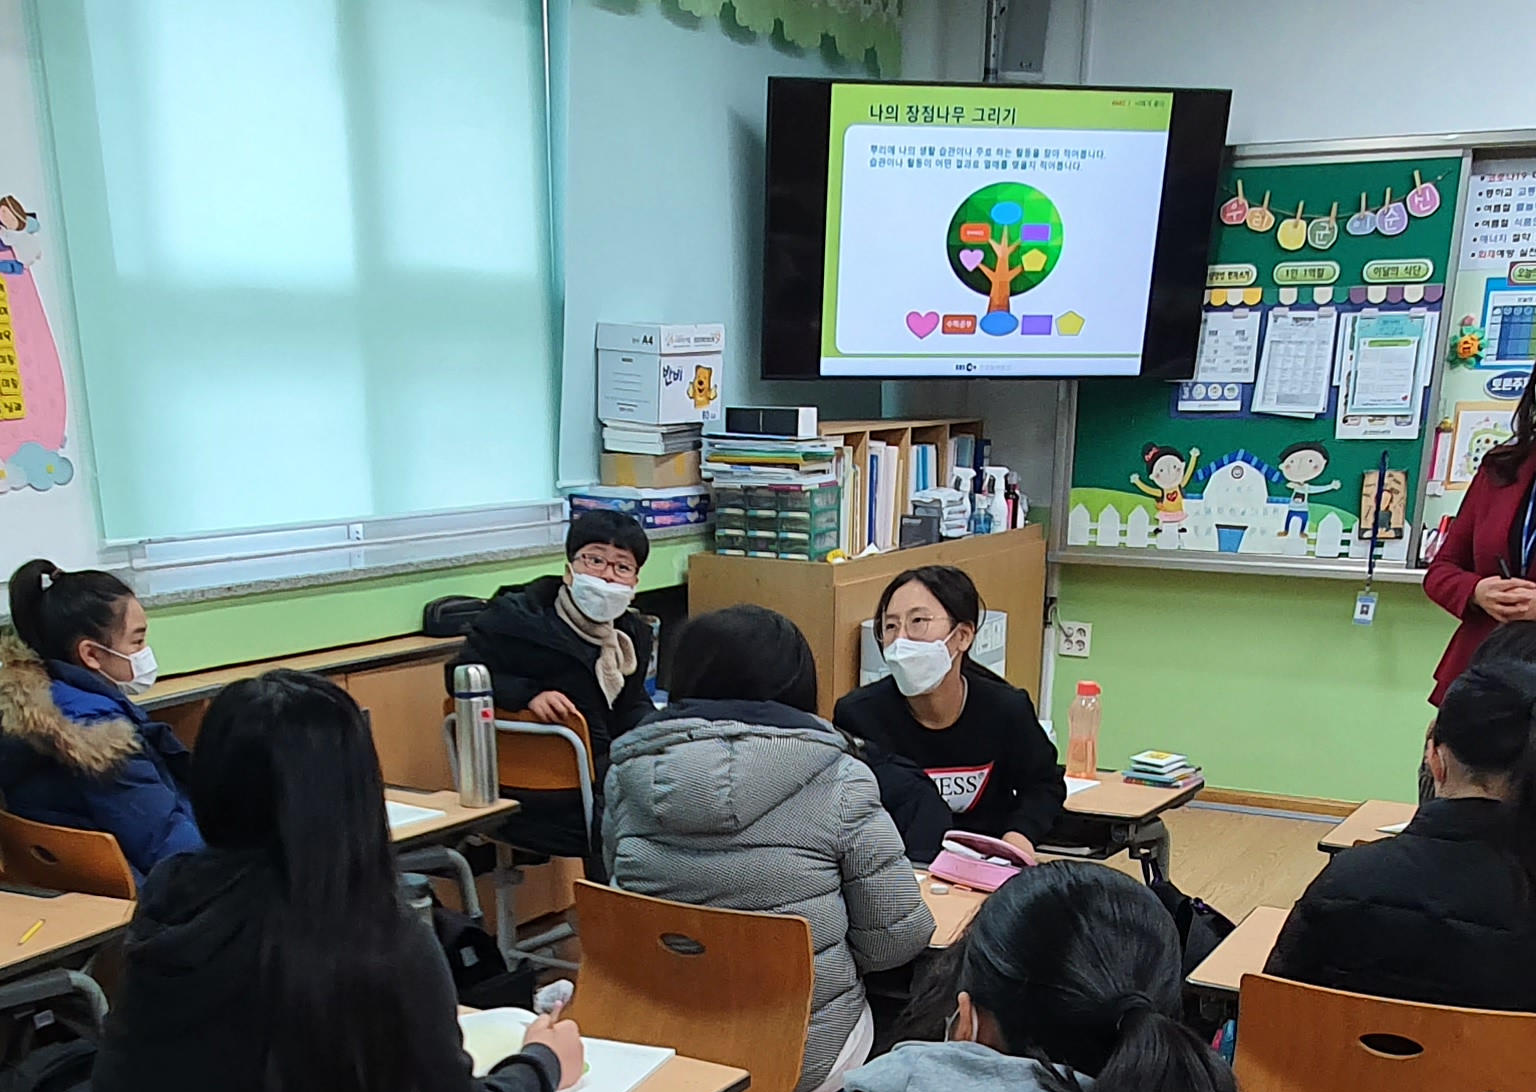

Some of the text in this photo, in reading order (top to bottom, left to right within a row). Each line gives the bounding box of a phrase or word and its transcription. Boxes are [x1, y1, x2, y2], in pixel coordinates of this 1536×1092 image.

[869, 104, 1016, 126] 나의 장점나무 그리기
[1373, 265, 1398, 277] 이달의
[1491, 377, 1530, 392] 토론주
[935, 775, 978, 796] ESS
